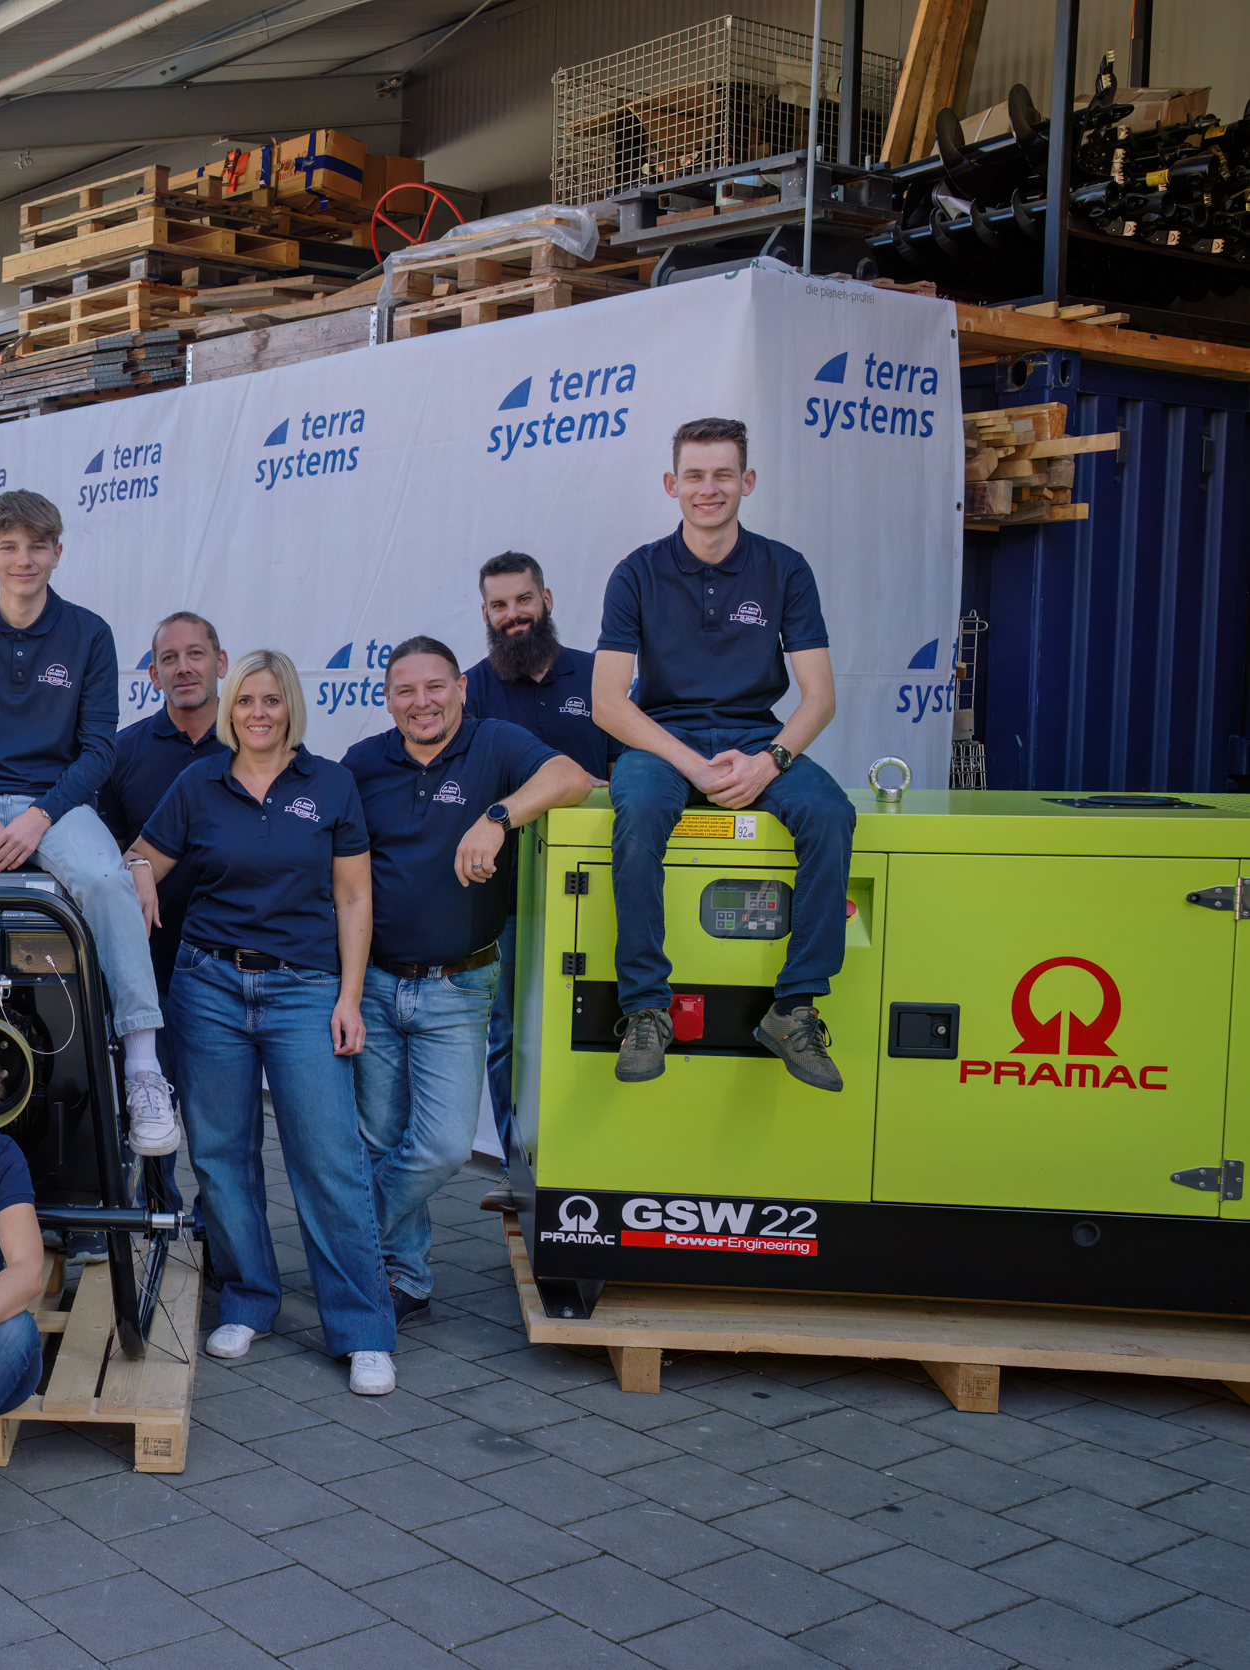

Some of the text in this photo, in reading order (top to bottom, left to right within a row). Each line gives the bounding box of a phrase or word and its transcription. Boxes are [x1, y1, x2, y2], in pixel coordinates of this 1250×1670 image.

[805, 283, 875, 304] die planen-profis!
[549, 363, 637, 404] terra
[865, 352, 938, 396] terra
[301, 408, 366, 441] terra
[487, 406, 629, 462] systems
[803, 392, 935, 439] systems
[113, 442, 162, 470] terra
[255, 442, 360, 490] systems
[78, 474, 160, 513] systems
[317, 676, 385, 715] syste
[896, 679, 955, 724] syst
[737, 826, 748, 838] 92
[959, 1060, 1169, 1091] PRAMAC
[621, 1198, 818, 1239] GSW 22
[540, 1231, 616, 1246] PRAMAC
[665, 1233, 810, 1254] PowerEngineering
